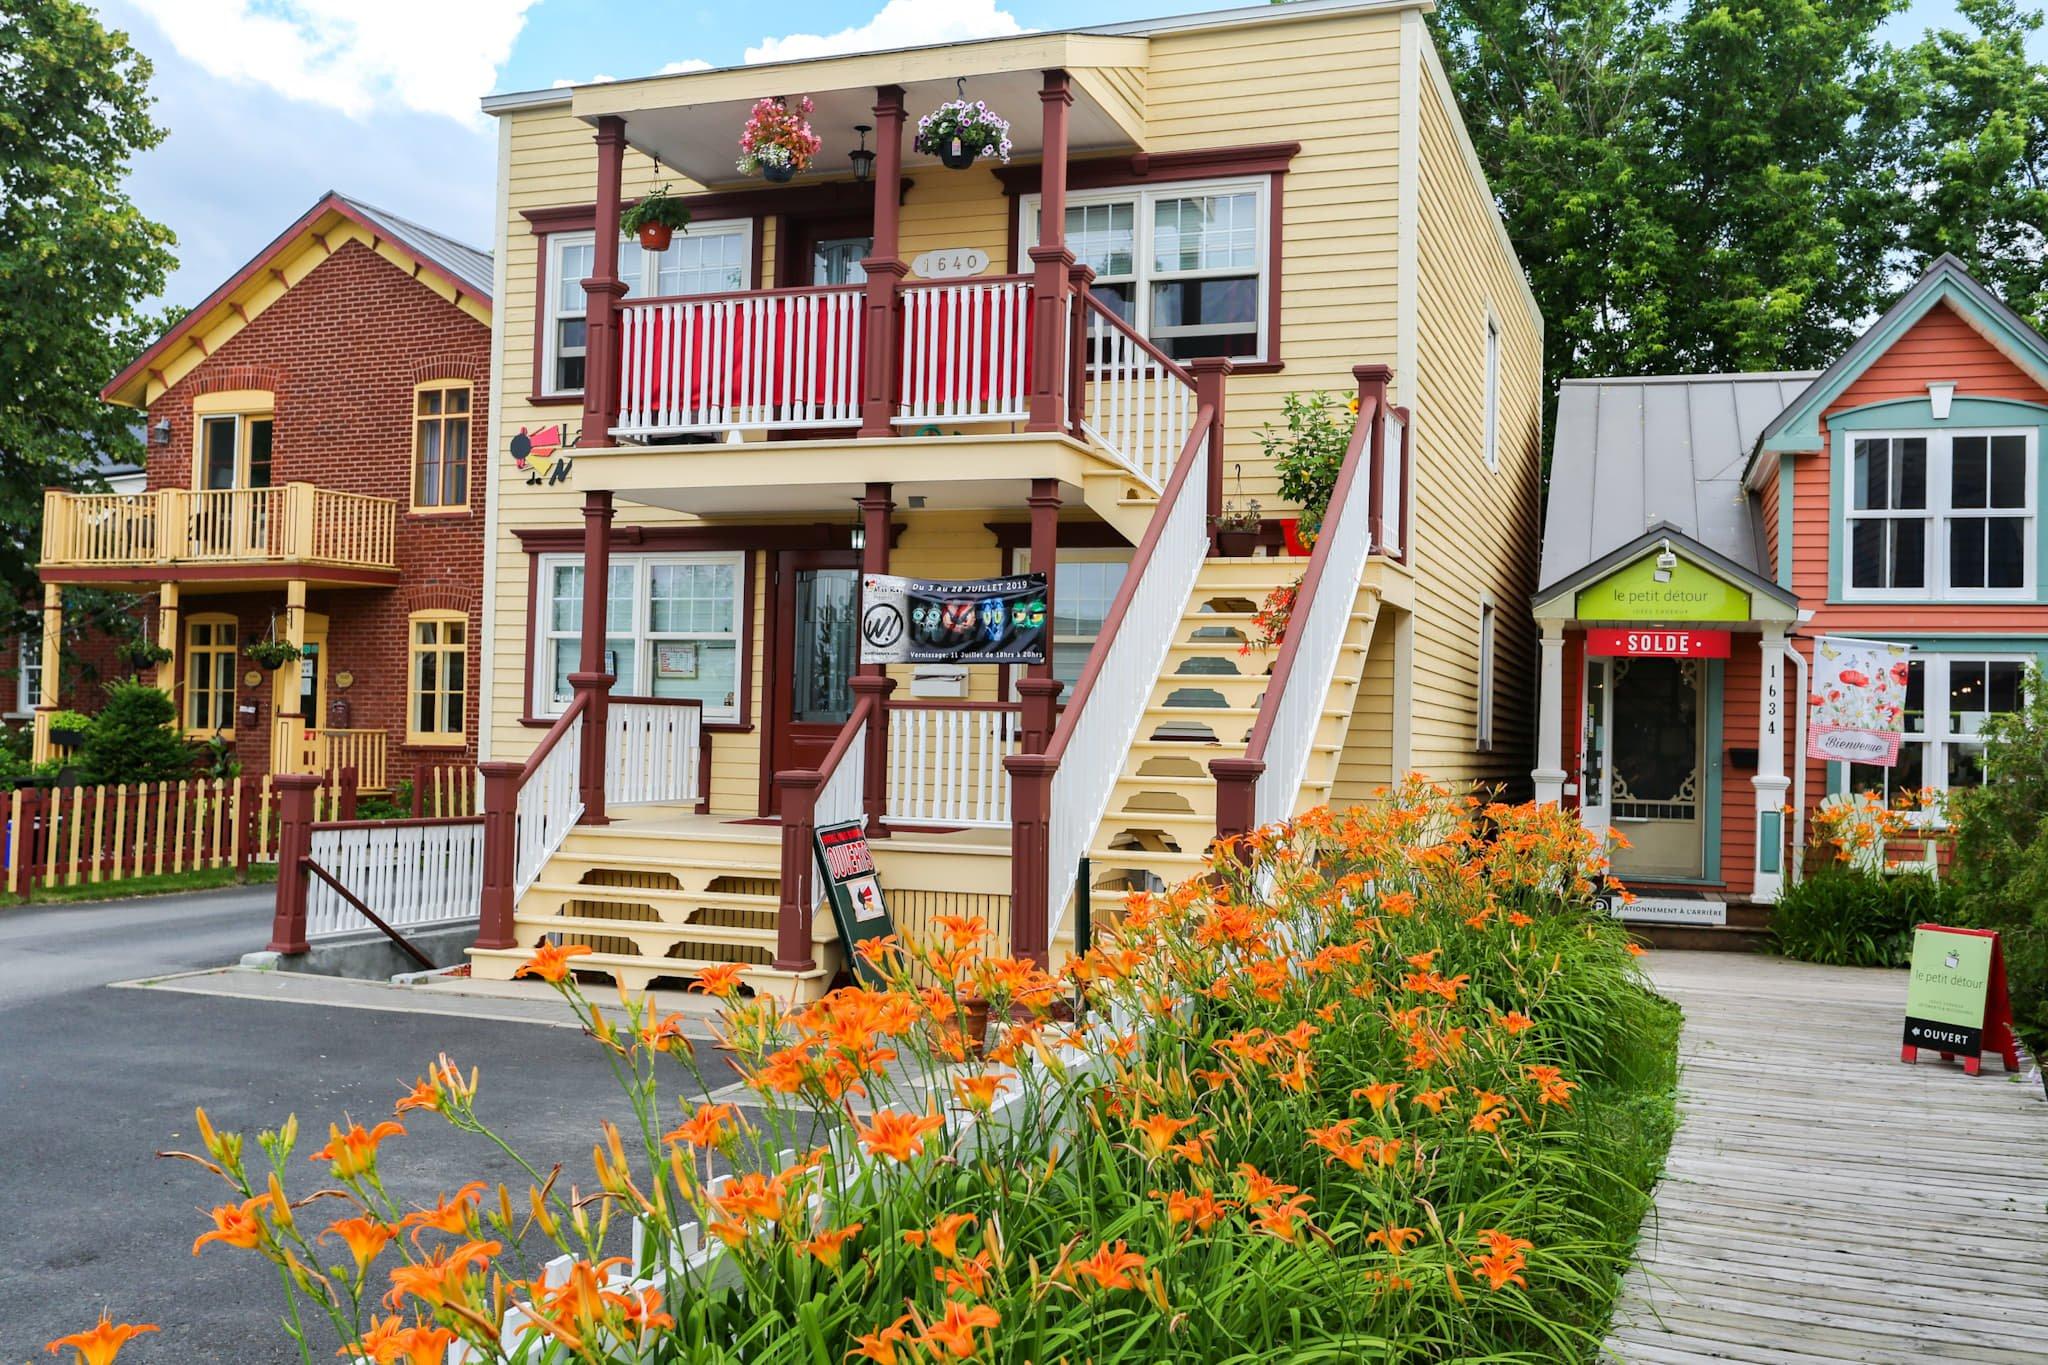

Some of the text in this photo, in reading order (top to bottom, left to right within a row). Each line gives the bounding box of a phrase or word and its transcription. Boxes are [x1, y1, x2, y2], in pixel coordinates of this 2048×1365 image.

[924, 255, 977, 273] 1640
[912, 583, 925, 591] Du
[928, 584, 935, 592] 3
[951, 585, 963, 593] 28
[965, 583, 1003, 593] JUILLET
[1006, 580, 1027, 591] 2019
[1614, 588, 1708, 605] le petit détour
[1627, 635, 1689, 652] SOLDE
[910, 651, 949, 660] Vernissage:
[960, 651, 984, 659] Juillet
[986, 651, 994, 659] de
[1768, 665, 1776, 735] 1634
[1825, 736, 1884, 753] Bienvenue
[1916, 969, 1924, 981] le
[1926, 972, 1947, 985] petit
[1924, 1028, 1969, 1046] OUVERT
